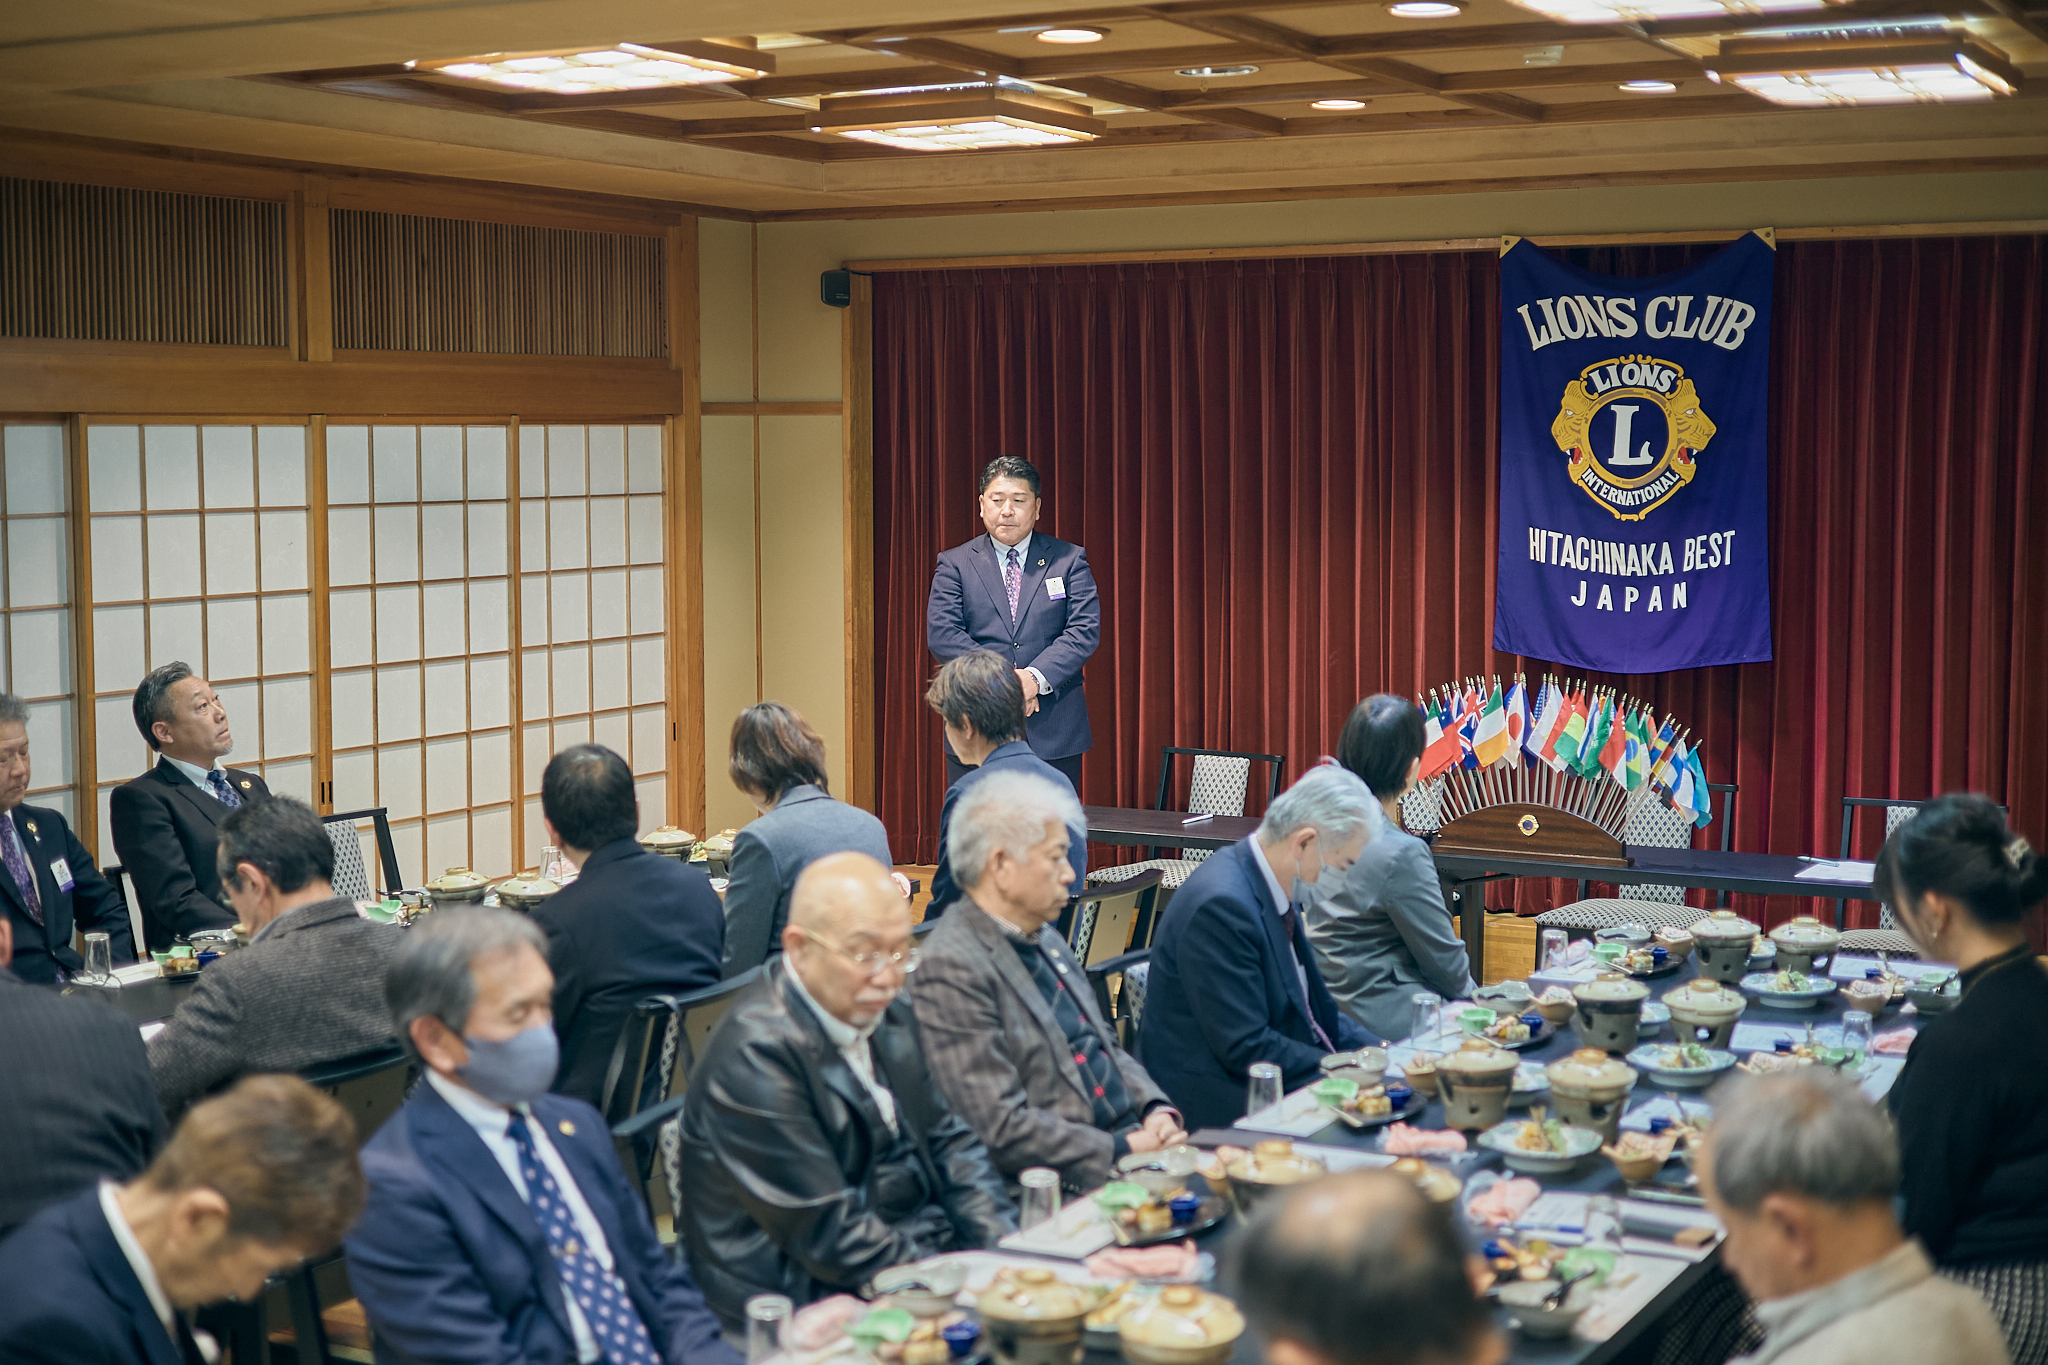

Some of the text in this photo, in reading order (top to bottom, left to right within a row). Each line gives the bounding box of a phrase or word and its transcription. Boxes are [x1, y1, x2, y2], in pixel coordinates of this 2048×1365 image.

[1516, 295, 1756, 351] LIONS CLUB
[1589, 363, 1677, 393] LIONS
[1608, 404, 1654, 466] L
[1582, 468, 1680, 506] INTERNATIONAL
[1529, 527, 1736, 577] HITACHINAKA BEST
[1570, 581, 1687, 612] JAPAN
